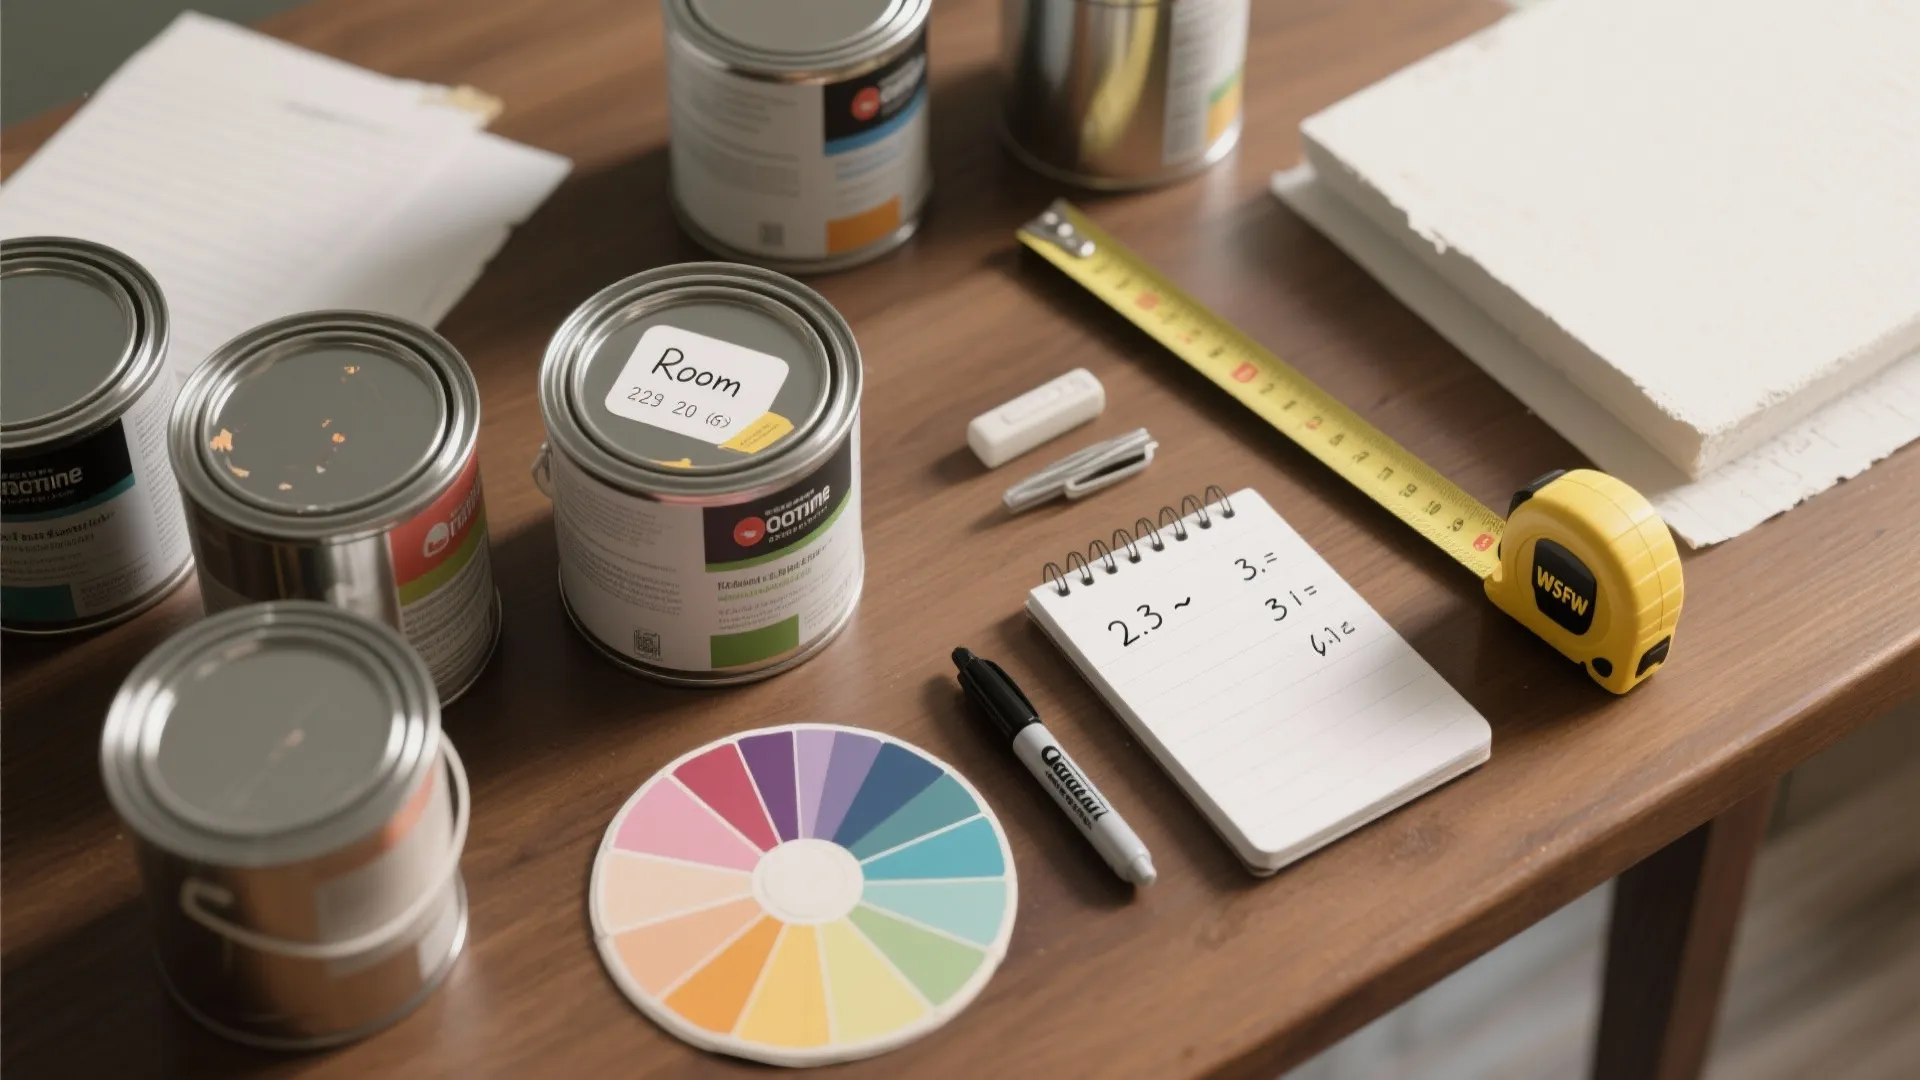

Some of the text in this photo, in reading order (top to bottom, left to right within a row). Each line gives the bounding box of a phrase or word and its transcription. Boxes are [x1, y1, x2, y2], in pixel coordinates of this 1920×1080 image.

[651, 347, 741, 398] Room
[671, 400, 698, 418] 20
[1537, 565, 1589, 616] WSFW
[1108, 604, 1163, 647] 2.3
